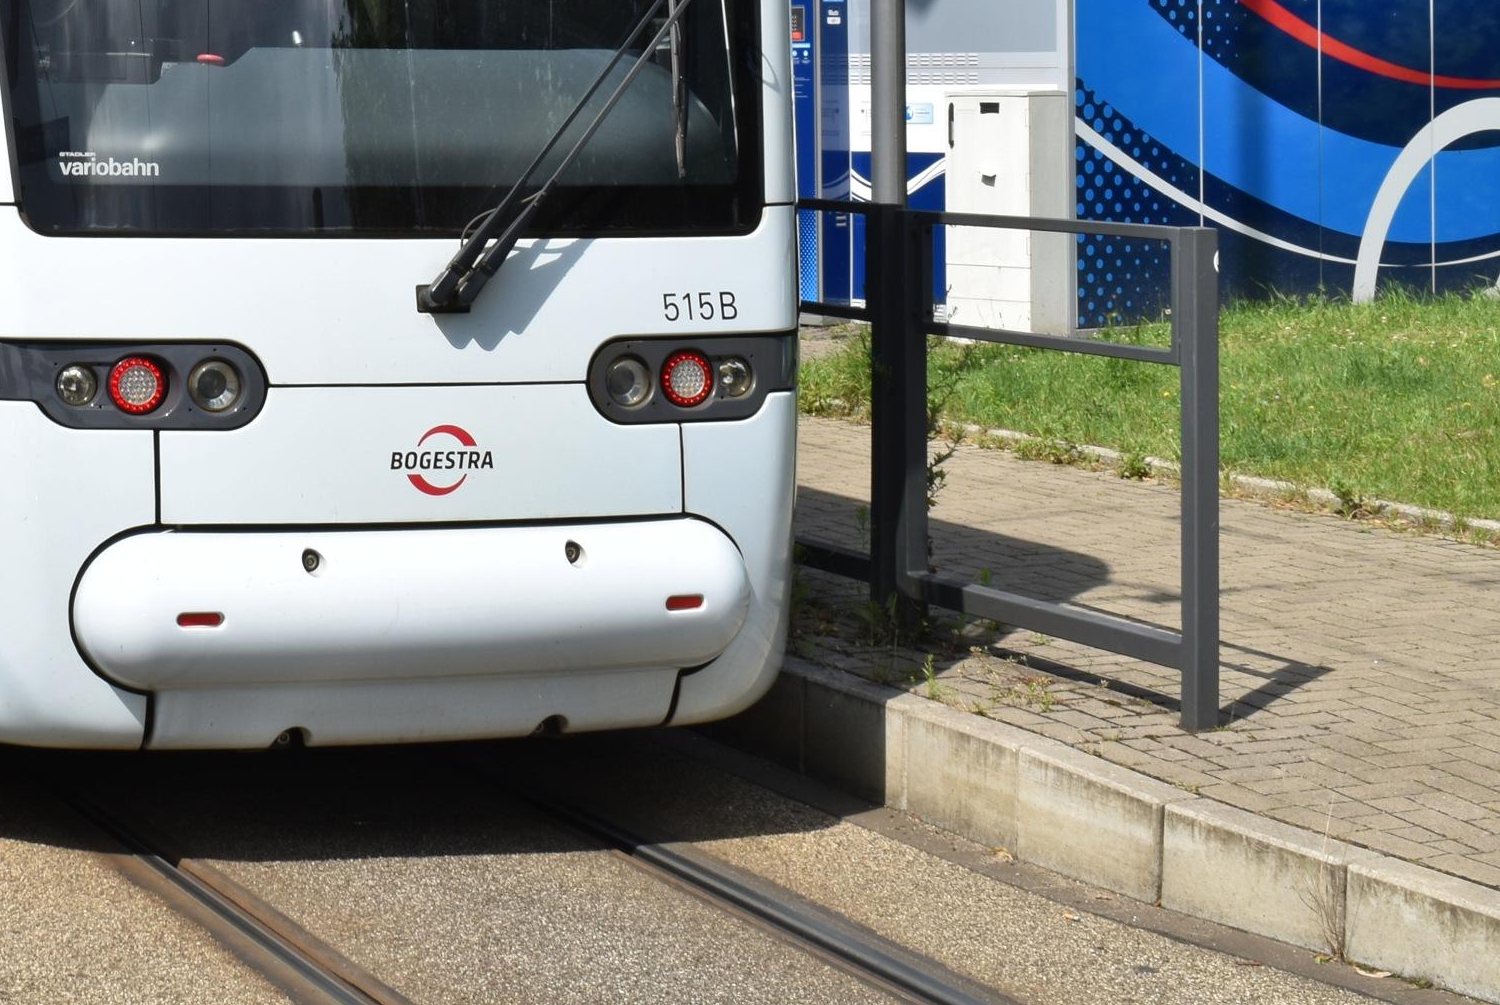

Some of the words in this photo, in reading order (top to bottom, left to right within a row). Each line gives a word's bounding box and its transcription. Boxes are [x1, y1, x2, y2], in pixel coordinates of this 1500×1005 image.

[59, 157, 159, 176] variobahn
[662, 291, 739, 321] 515B
[390, 450, 494, 470] BOGESTRA
